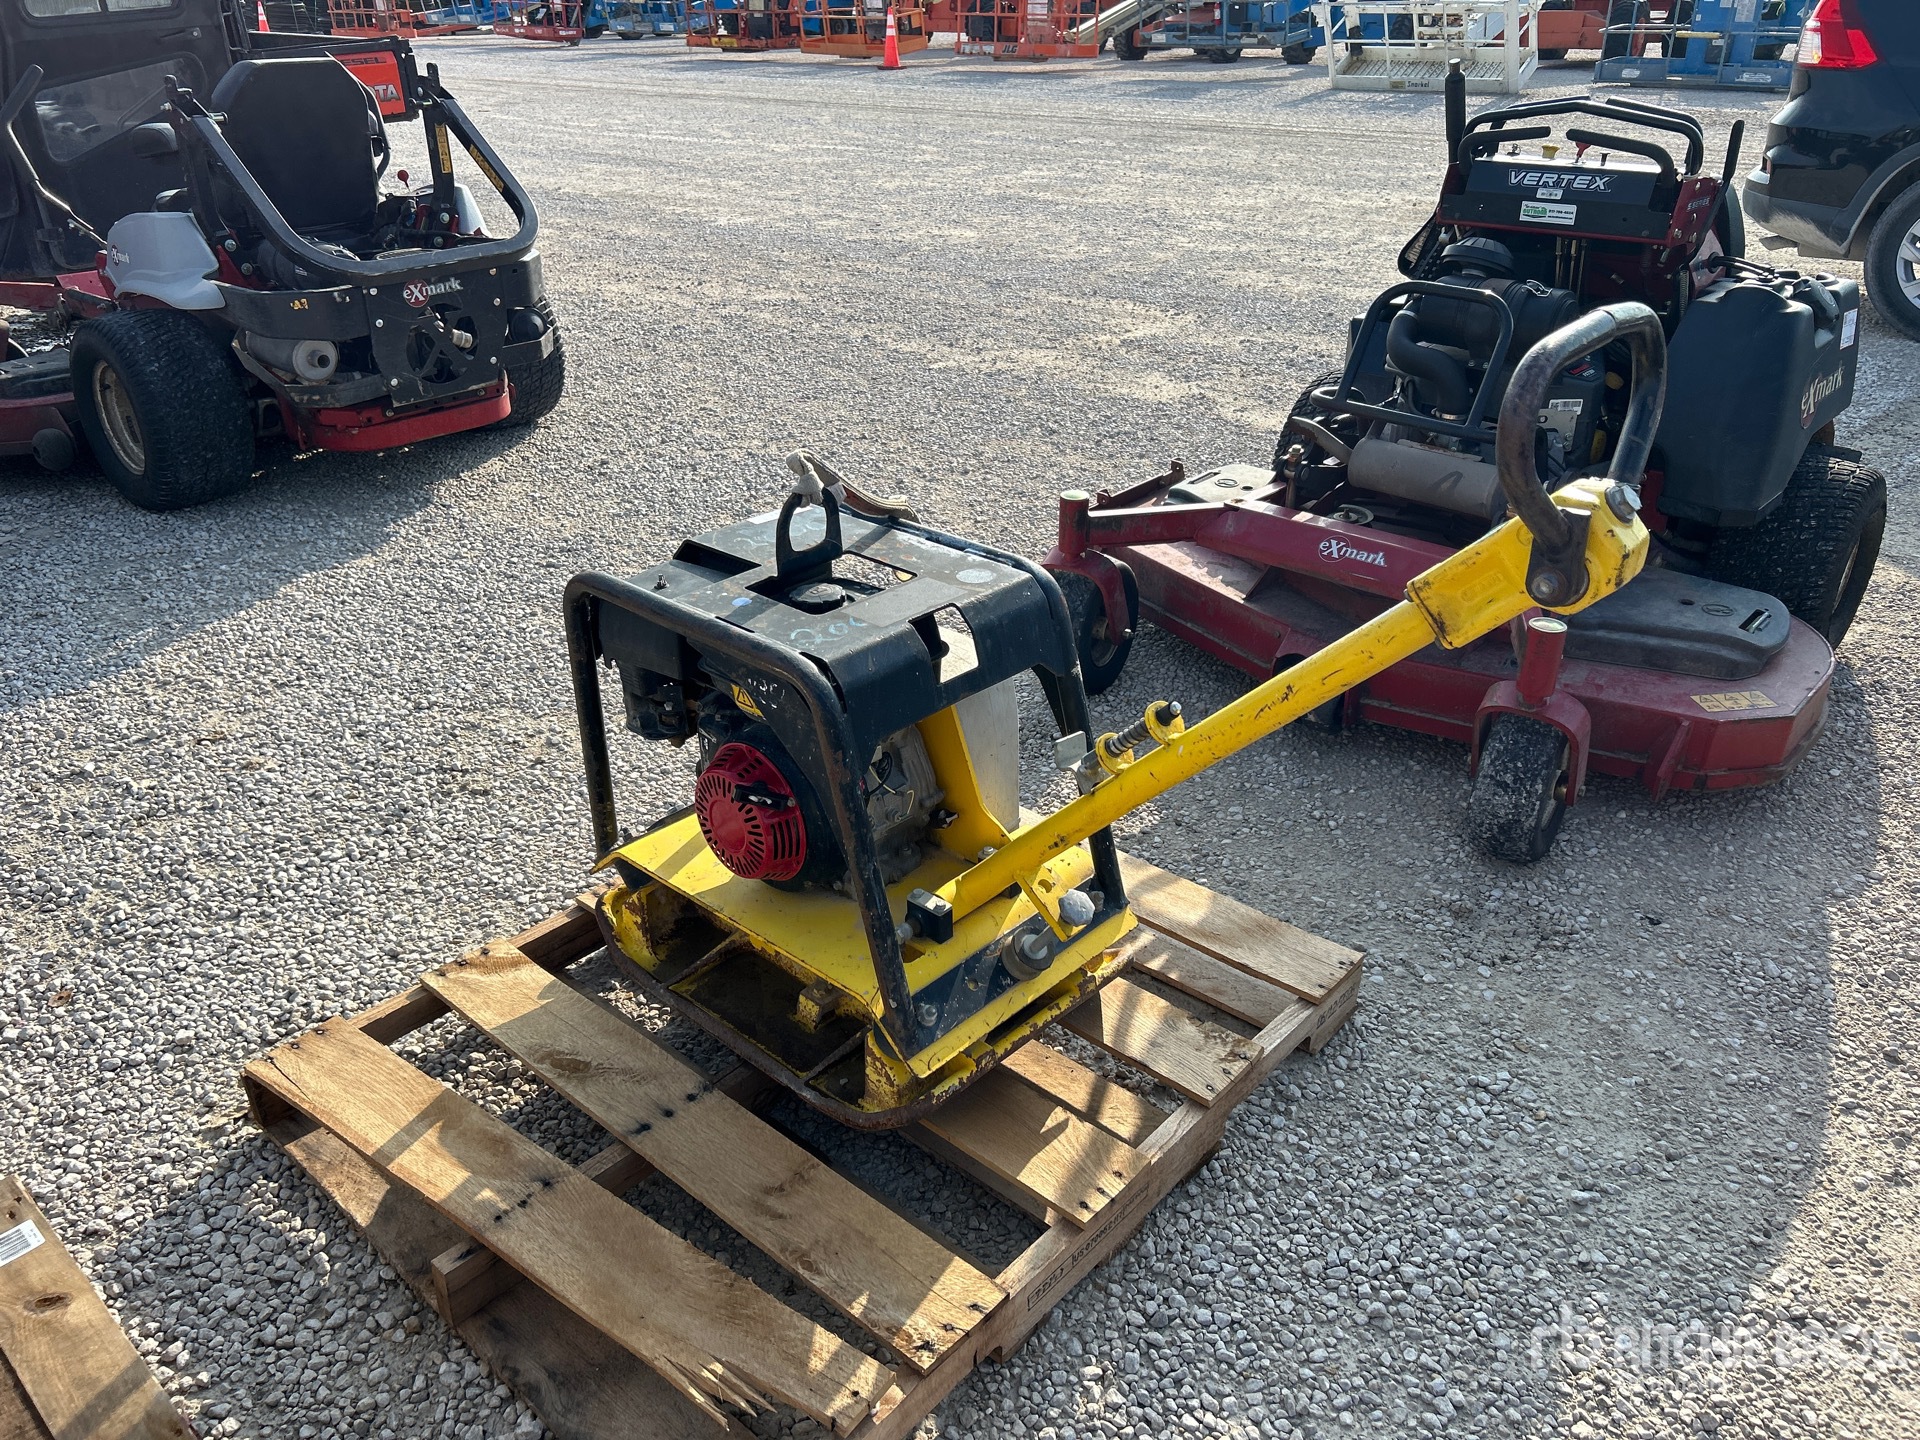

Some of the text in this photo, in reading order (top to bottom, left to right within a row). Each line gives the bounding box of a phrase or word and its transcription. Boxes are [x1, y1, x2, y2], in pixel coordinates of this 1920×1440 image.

[1001, 44, 1018, 54] JLG
[1509, 169, 1616, 191] VERTEX
[403, 277, 464, 303] eXmark
[1801, 360, 1845, 419] eXmark
[1319, 539, 1387, 567] eXmark
